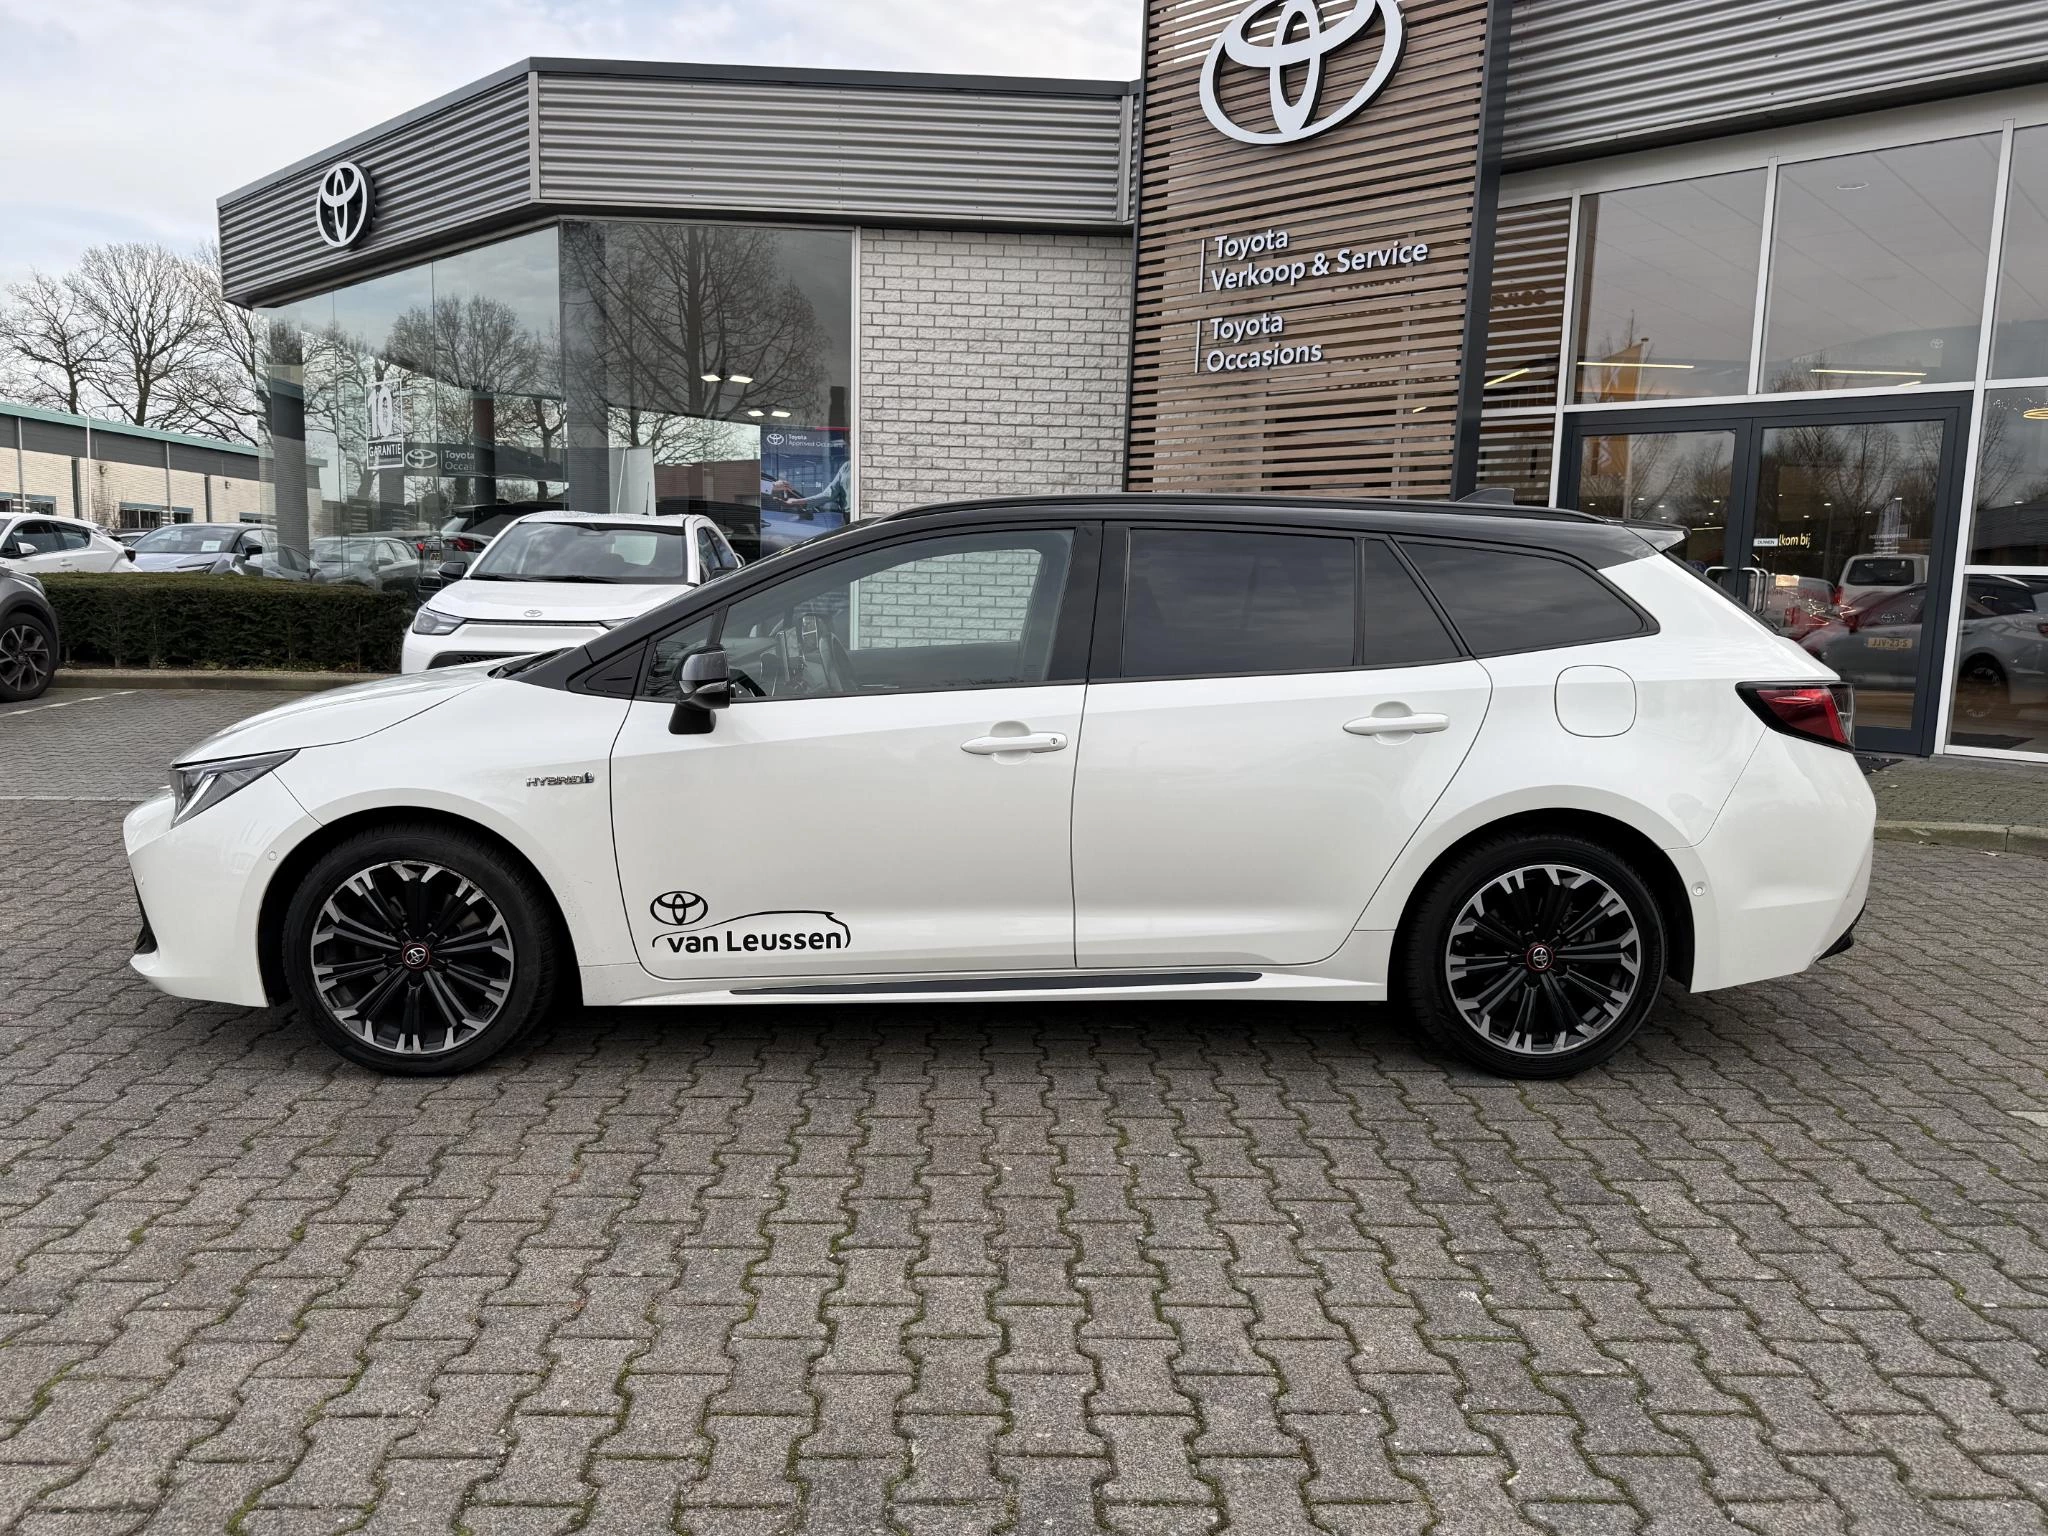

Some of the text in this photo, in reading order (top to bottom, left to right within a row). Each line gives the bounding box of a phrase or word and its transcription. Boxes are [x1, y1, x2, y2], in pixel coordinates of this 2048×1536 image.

[1214, 228, 1289, 261] Toyota
[1211, 240, 1429, 291] Verkoop & Service
[1210, 312, 1284, 343] Toyota
[1206, 342, 1323, 373] Occasions
[369, 443, 402, 457] GARANTIE
[445, 450, 475, 460] Toyota
[445, 461, 476, 470] Occasi
[1778, 533, 1798, 547] lkom
[526, 775, 584, 787] HYBRID
[667, 931, 842, 953] van Leussen
